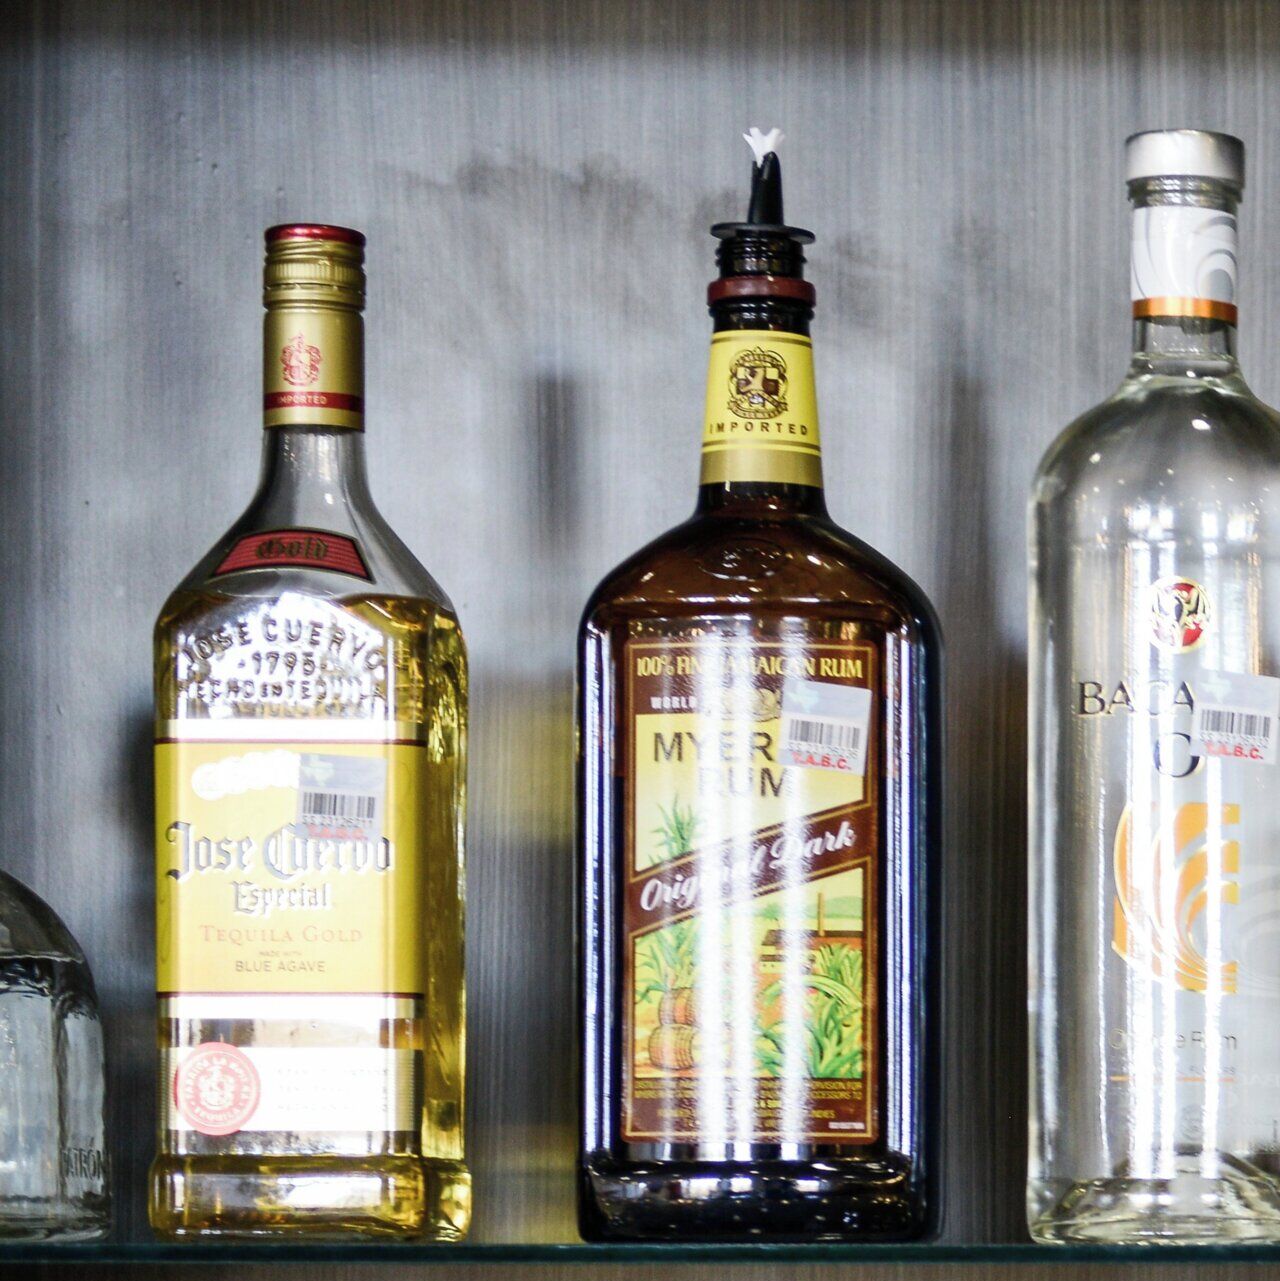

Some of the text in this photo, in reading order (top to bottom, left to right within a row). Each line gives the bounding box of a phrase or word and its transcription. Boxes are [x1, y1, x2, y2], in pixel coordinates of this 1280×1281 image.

[276, 394, 328, 406] IMPORTED
[709, 421, 808, 436] IMPORTED
[637, 655, 863, 678] 100% RUM
[165, 820, 393, 881] Jose Cuervo
[232, 880, 330, 914] Especial
[235, 960, 326, 973] BLUE AGAVE
